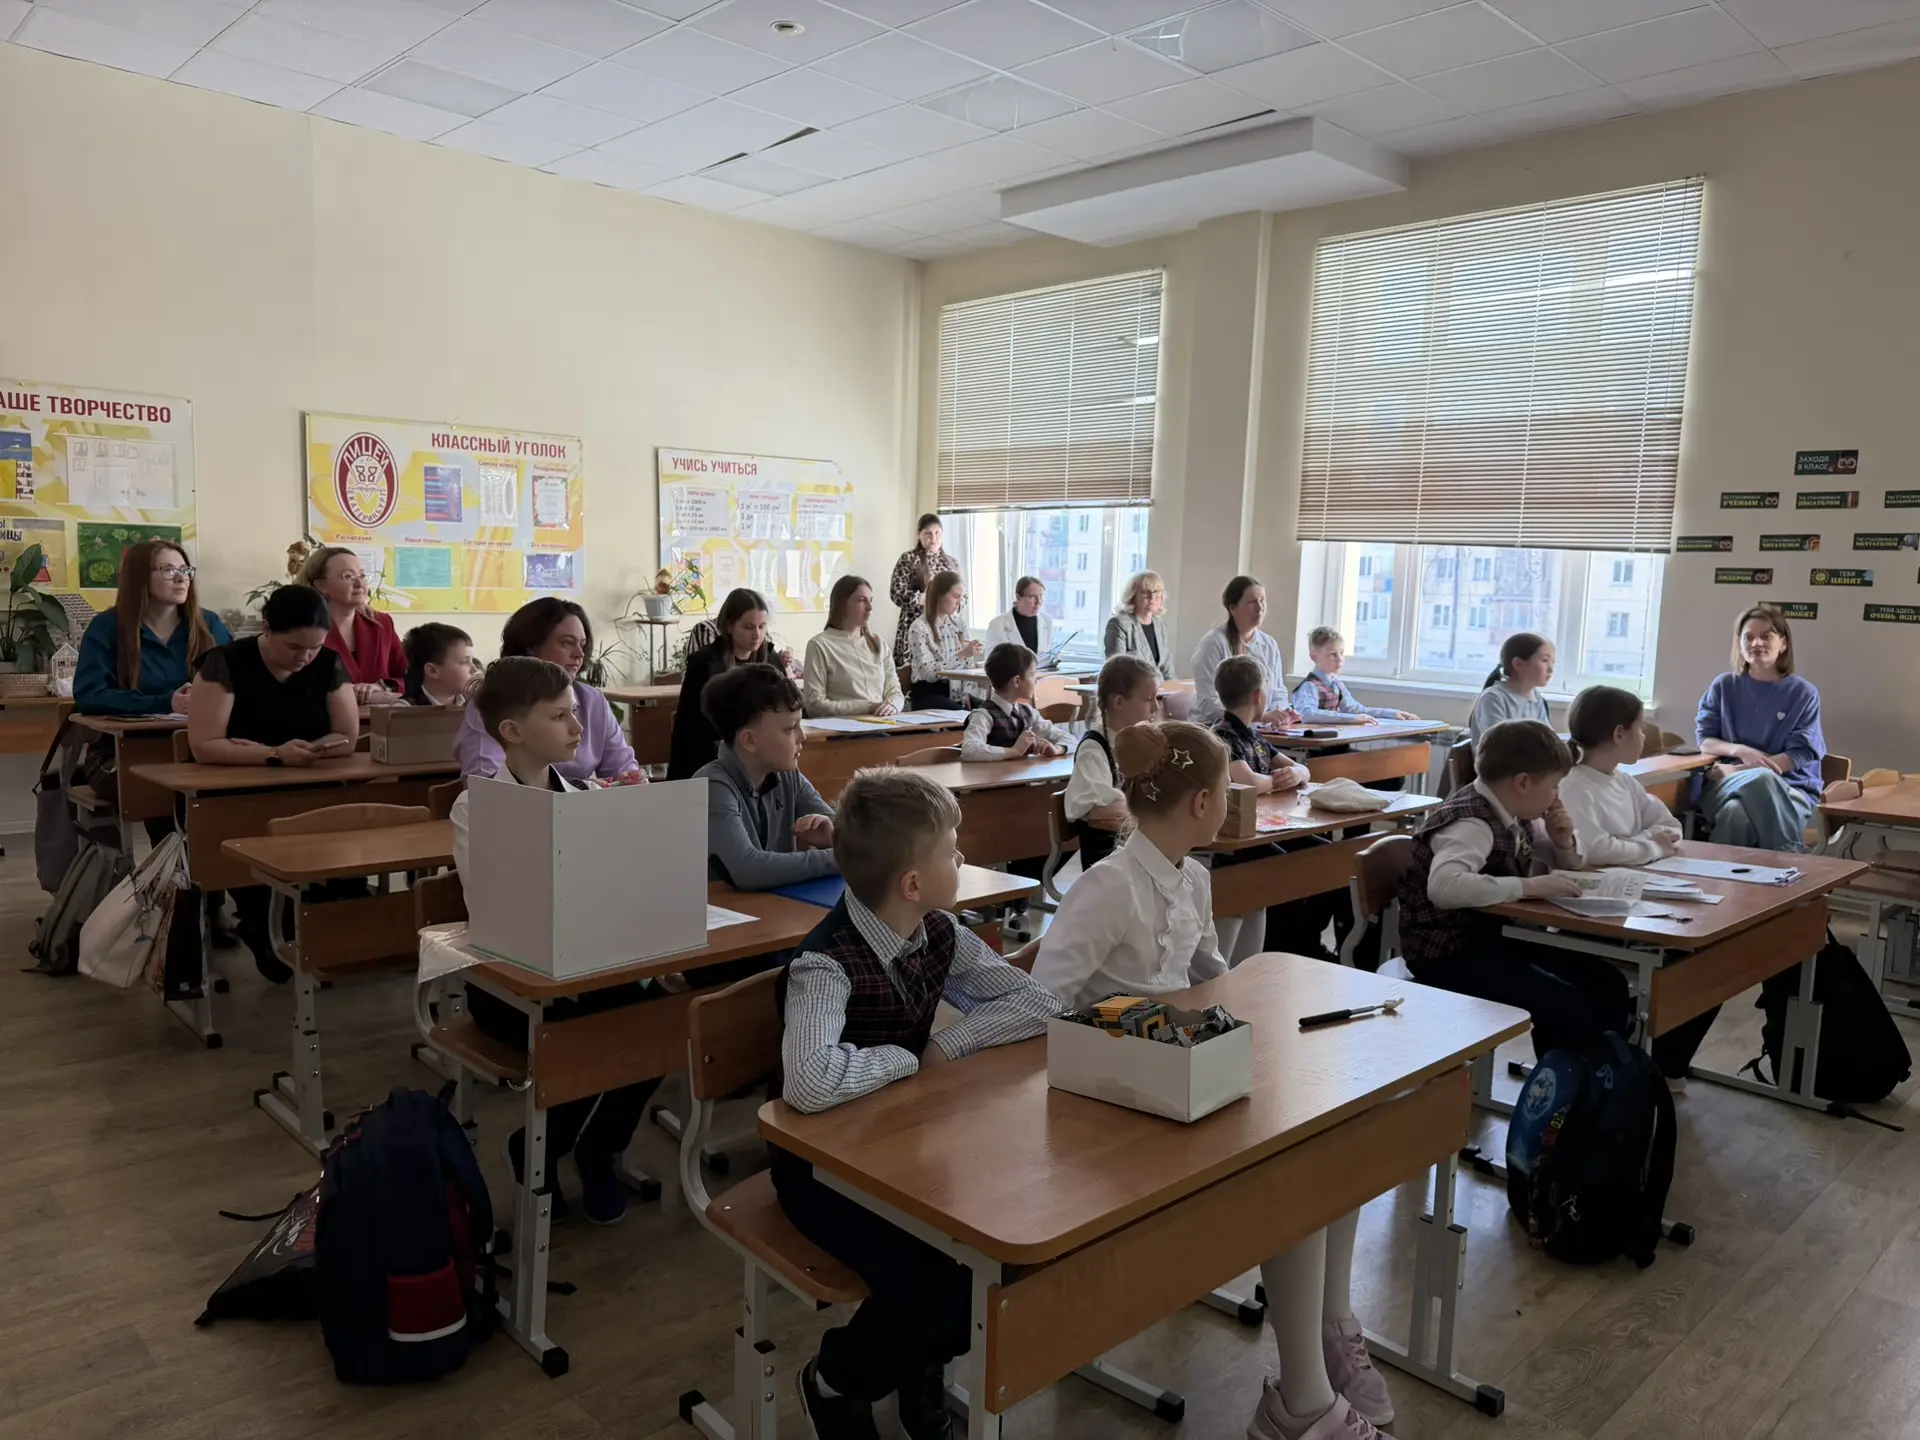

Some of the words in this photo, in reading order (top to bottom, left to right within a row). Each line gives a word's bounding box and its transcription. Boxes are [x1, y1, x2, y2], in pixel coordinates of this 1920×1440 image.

[47, 395, 171, 423] ТВОРЧЕСТВО
[343, 437, 390, 472] ЛИЦЕЙ
[431, 432, 510, 454] КЛАССНЫЙ
[514, 441, 567, 459] УГОЛОК
[355, 465, 377, 482] 88
[672, 457, 708, 472] УЧИСЬ
[711, 460, 757, 476] УЧИТЬСЯ
